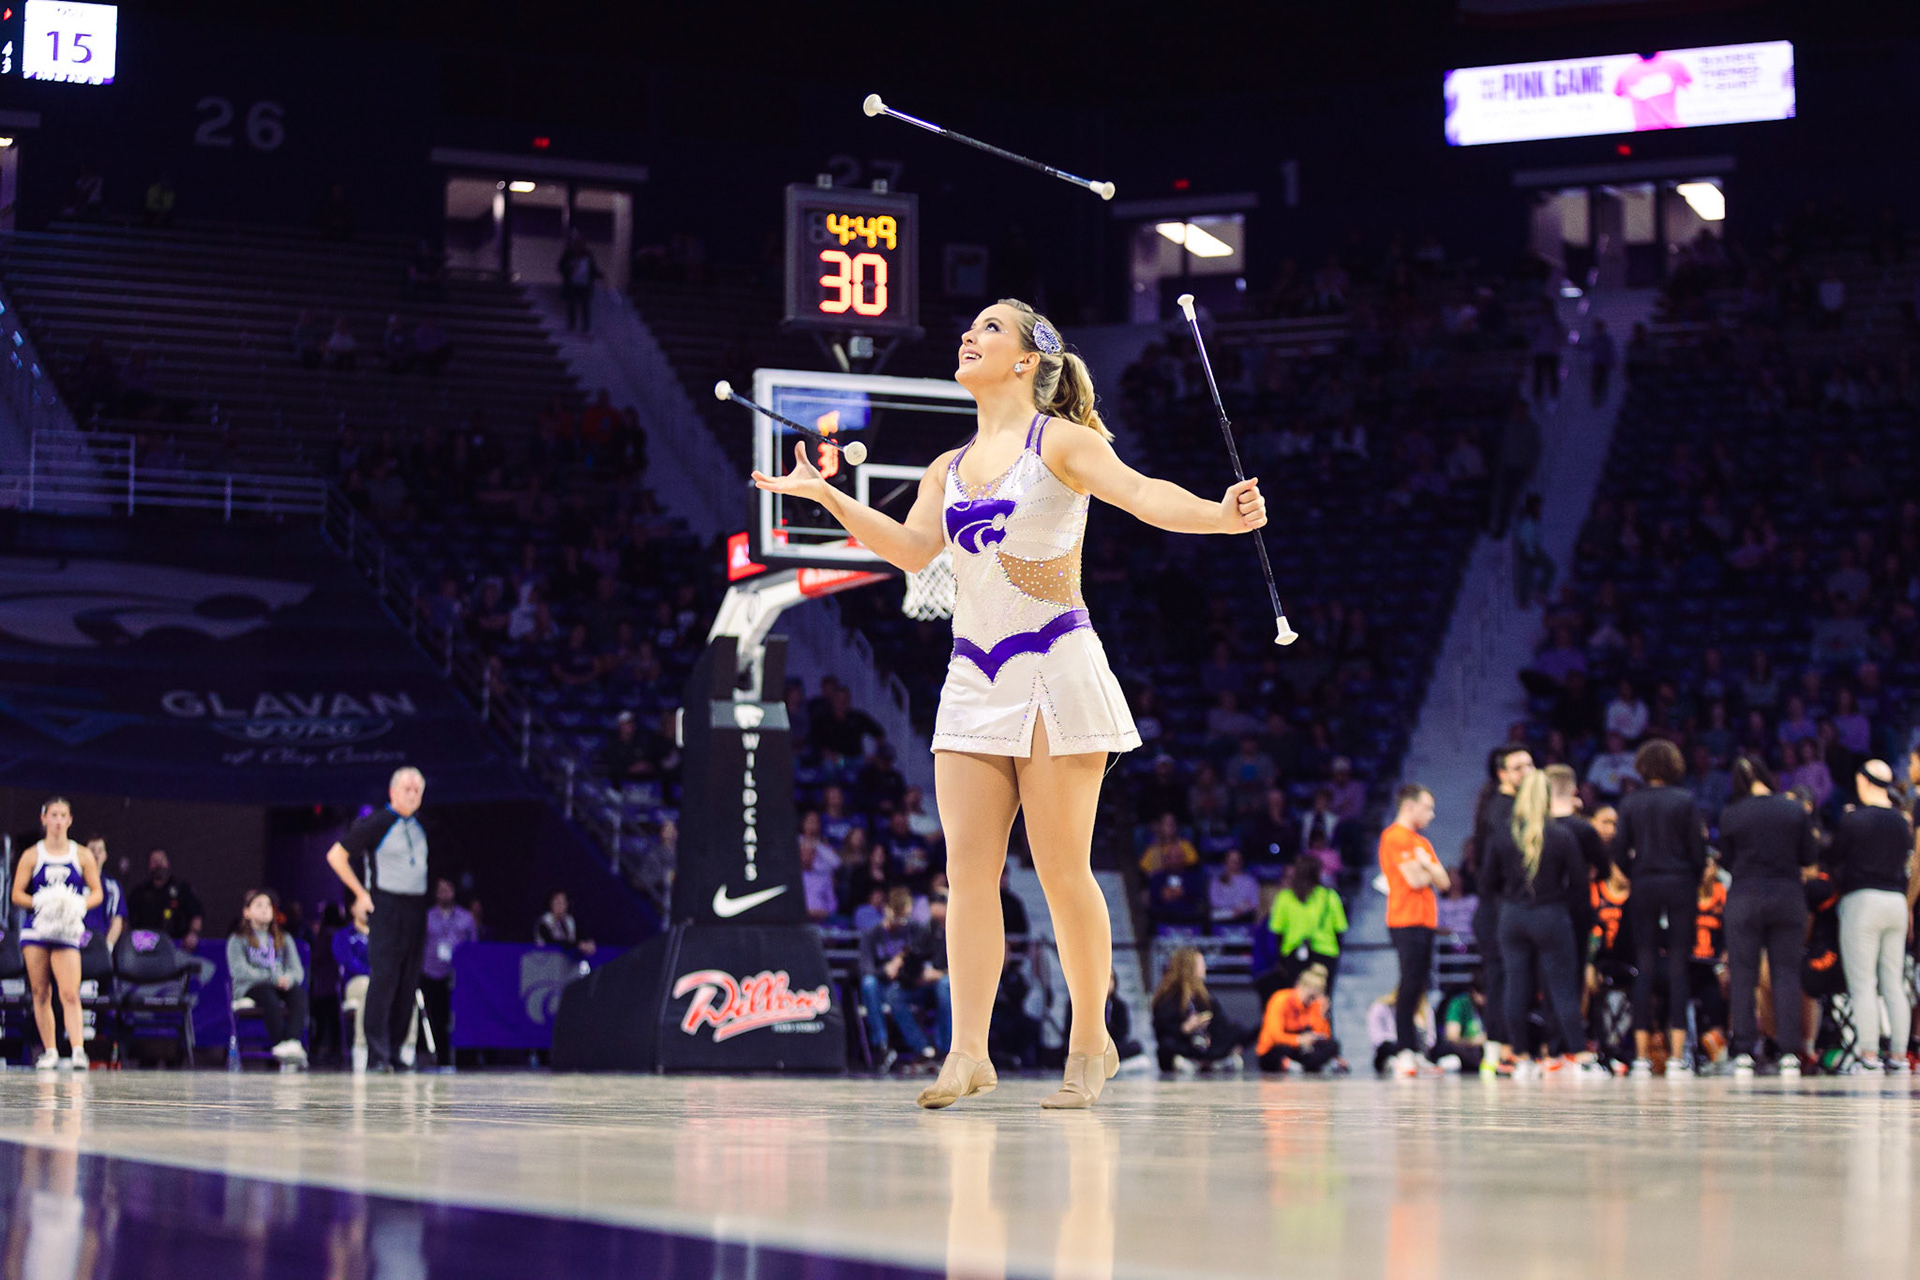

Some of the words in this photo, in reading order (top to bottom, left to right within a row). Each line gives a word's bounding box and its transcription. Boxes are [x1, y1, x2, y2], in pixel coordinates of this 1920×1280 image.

[46, 30, 94, 64] 15
[1503, 70, 1548, 101] PINK
[1554, 66, 1604, 97] GAME
[194, 97, 286, 150] 26
[828, 154, 905, 192] 27
[826, 213, 898, 250] 4:49
[818, 249, 889, 317] 30
[160, 689, 418, 719] GLAVAN
[742, 732, 760, 882] WILDCATS
[673, 969, 832, 1043] Dillons
